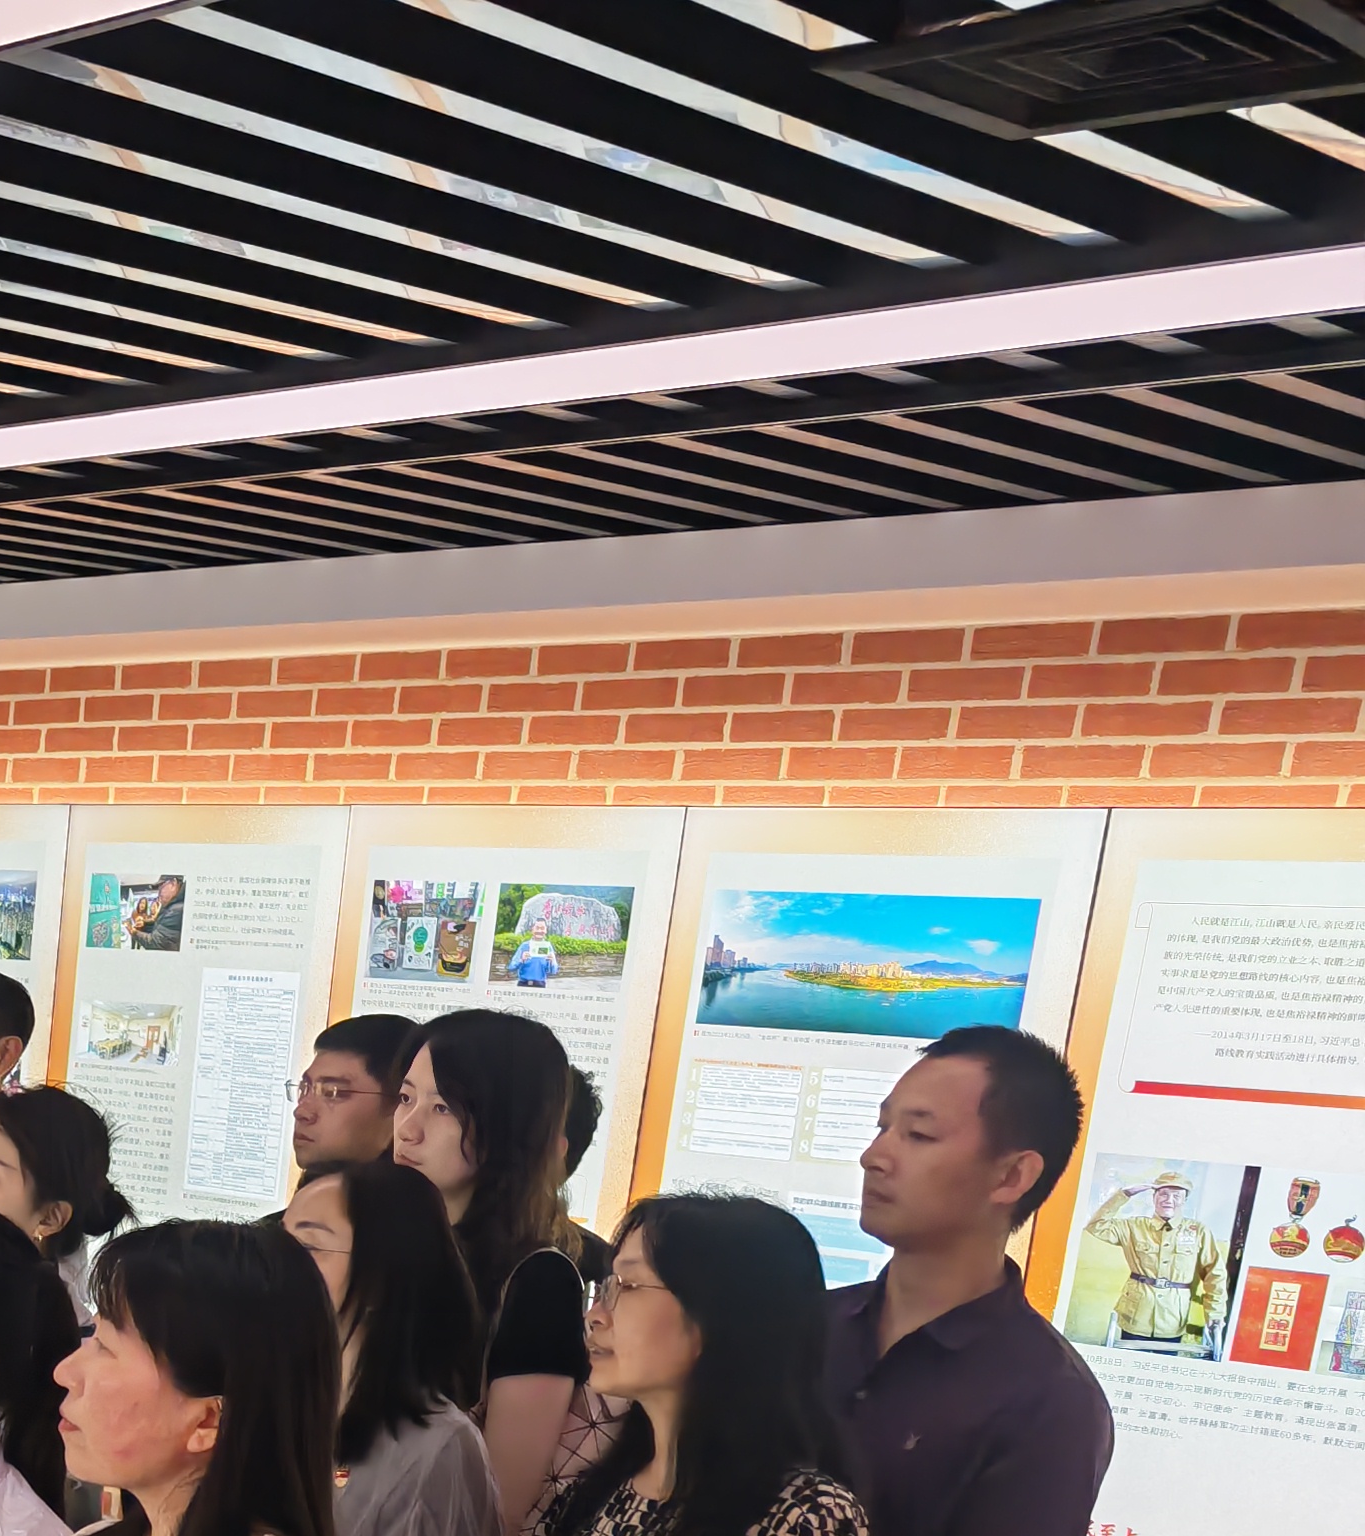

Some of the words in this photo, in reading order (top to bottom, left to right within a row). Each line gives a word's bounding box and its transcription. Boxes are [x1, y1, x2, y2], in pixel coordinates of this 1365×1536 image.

[809, 1072, 819, 1085] 5
[686, 1089, 696, 1103] 2
[806, 1095, 816, 1108] 6
[682, 1111, 692, 1125] 3
[803, 1117, 813, 1131] 7
[799, 1139, 809, 1153] 8
